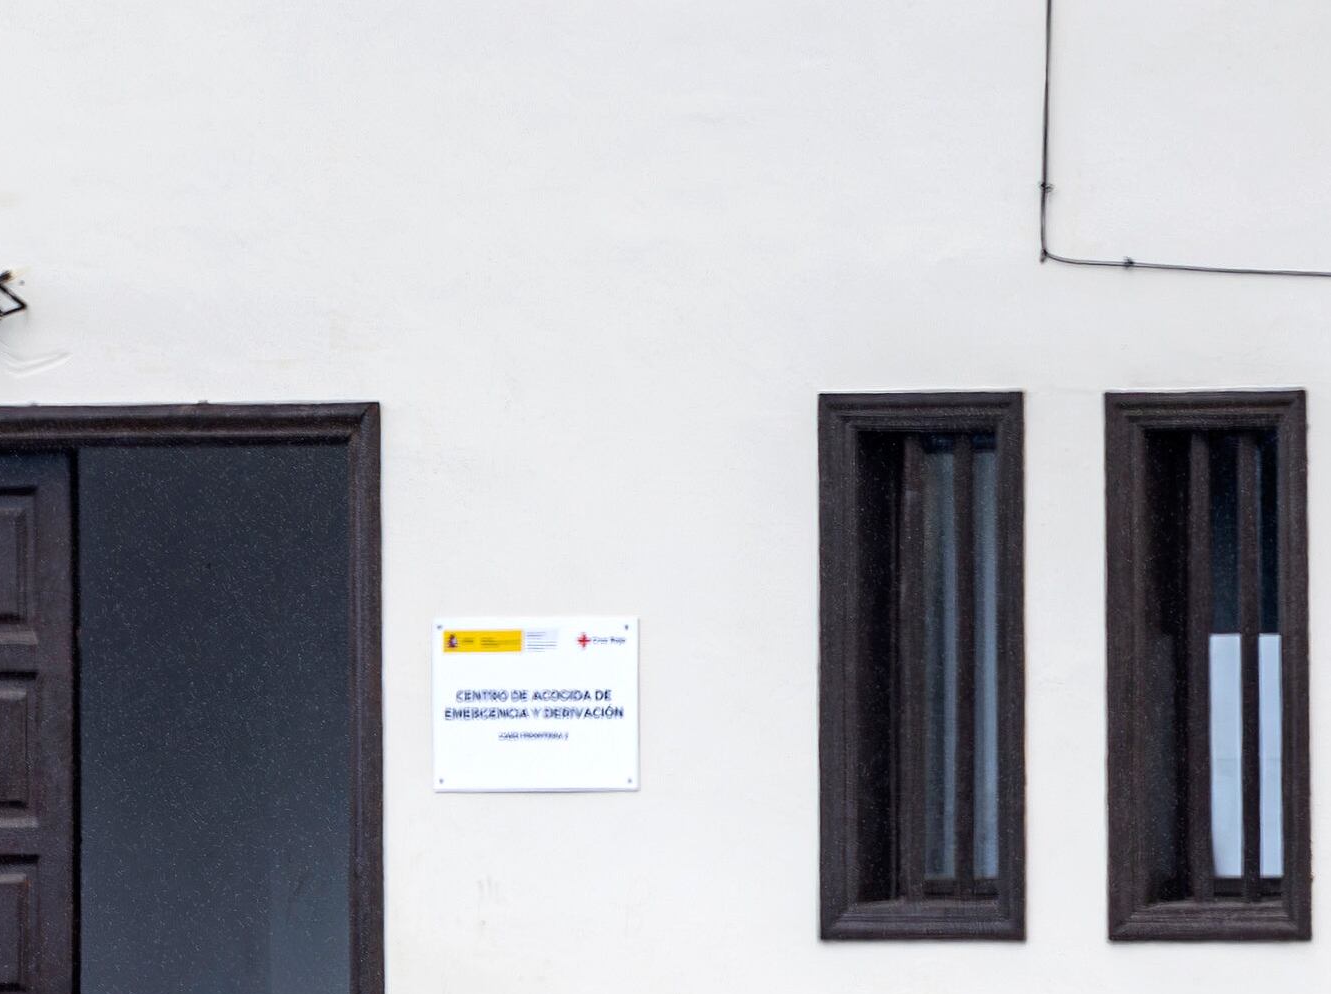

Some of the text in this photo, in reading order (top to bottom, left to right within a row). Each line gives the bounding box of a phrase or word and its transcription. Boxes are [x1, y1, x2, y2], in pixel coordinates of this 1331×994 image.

[455, 689, 612, 702] CENTRO DE ACOGIDA DE
[444, 704, 624, 720] EMERGENCIA Y DERIVACIÓN
